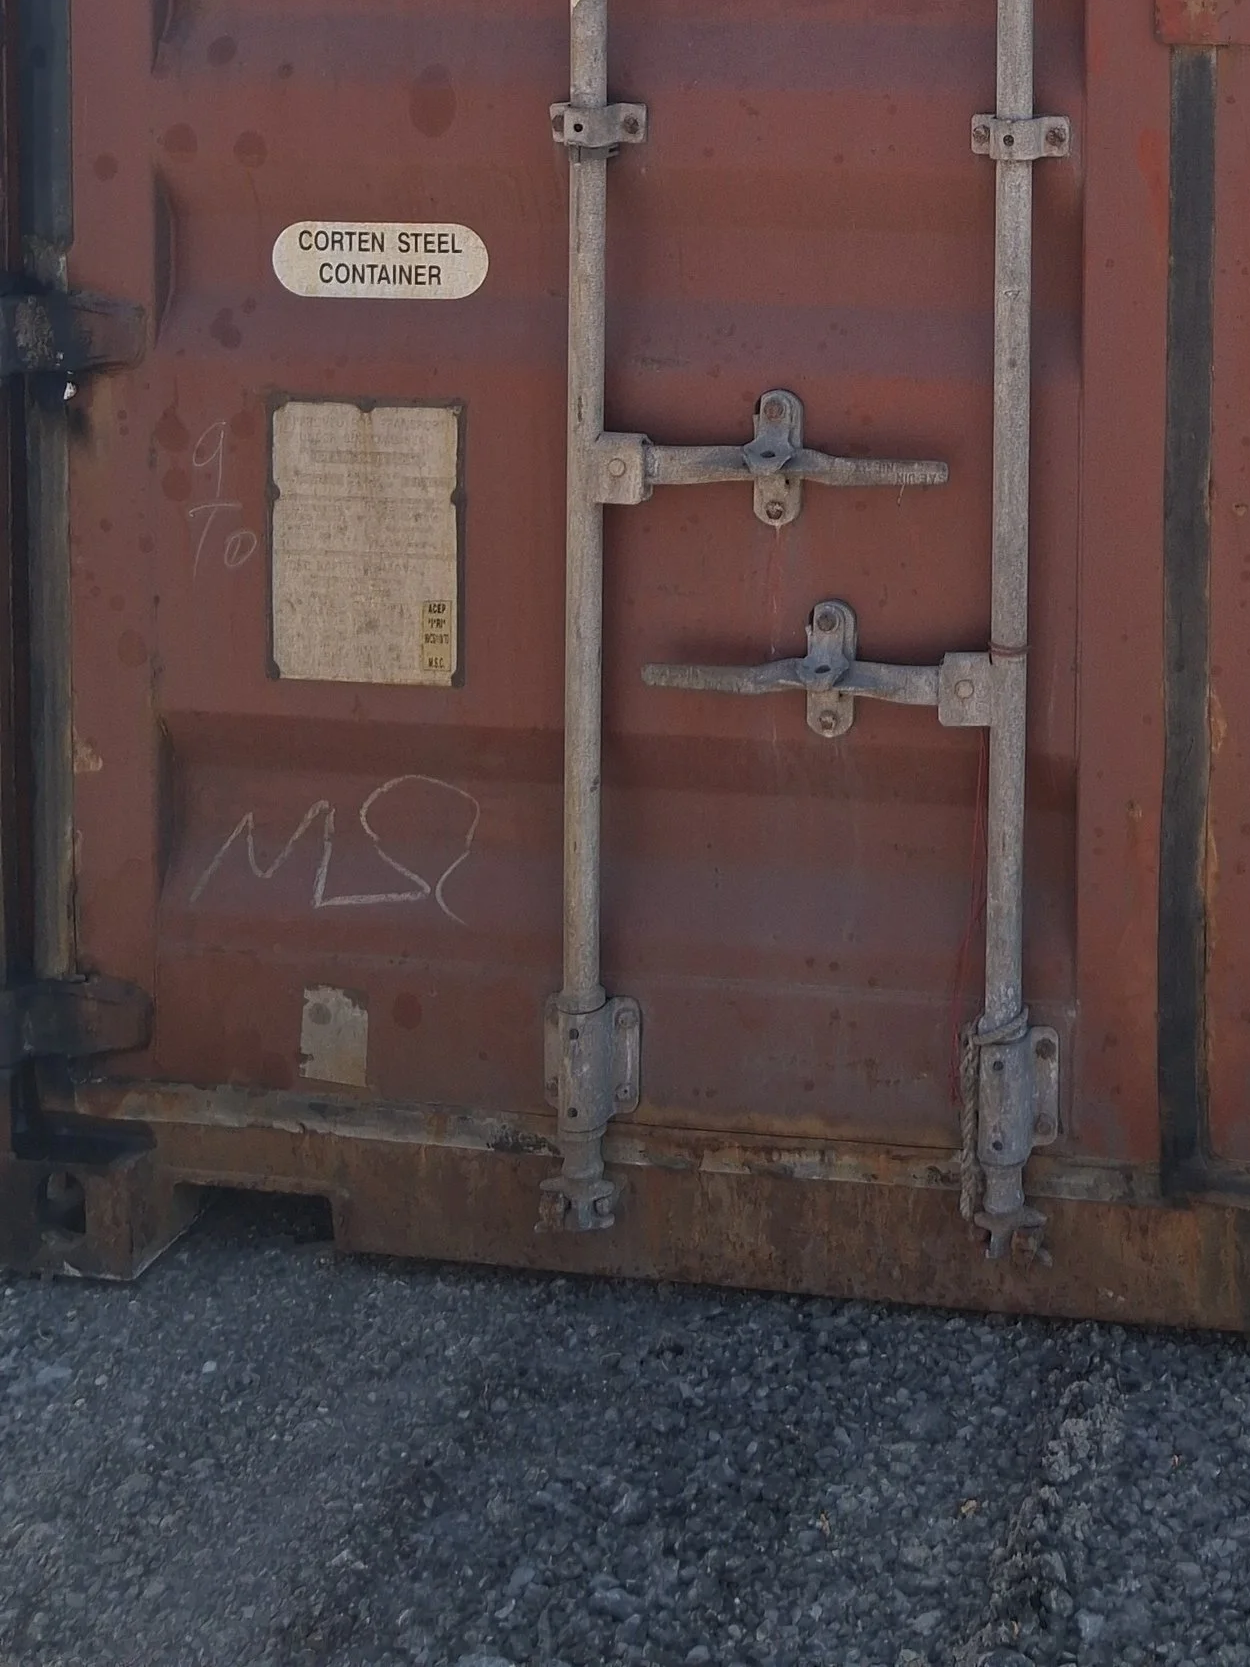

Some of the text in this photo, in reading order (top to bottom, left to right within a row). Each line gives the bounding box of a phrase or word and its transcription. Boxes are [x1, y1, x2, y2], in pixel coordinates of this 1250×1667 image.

[298, 230, 462, 254] CORTEN STEEL
[319, 263, 442, 285] CONTAINER
